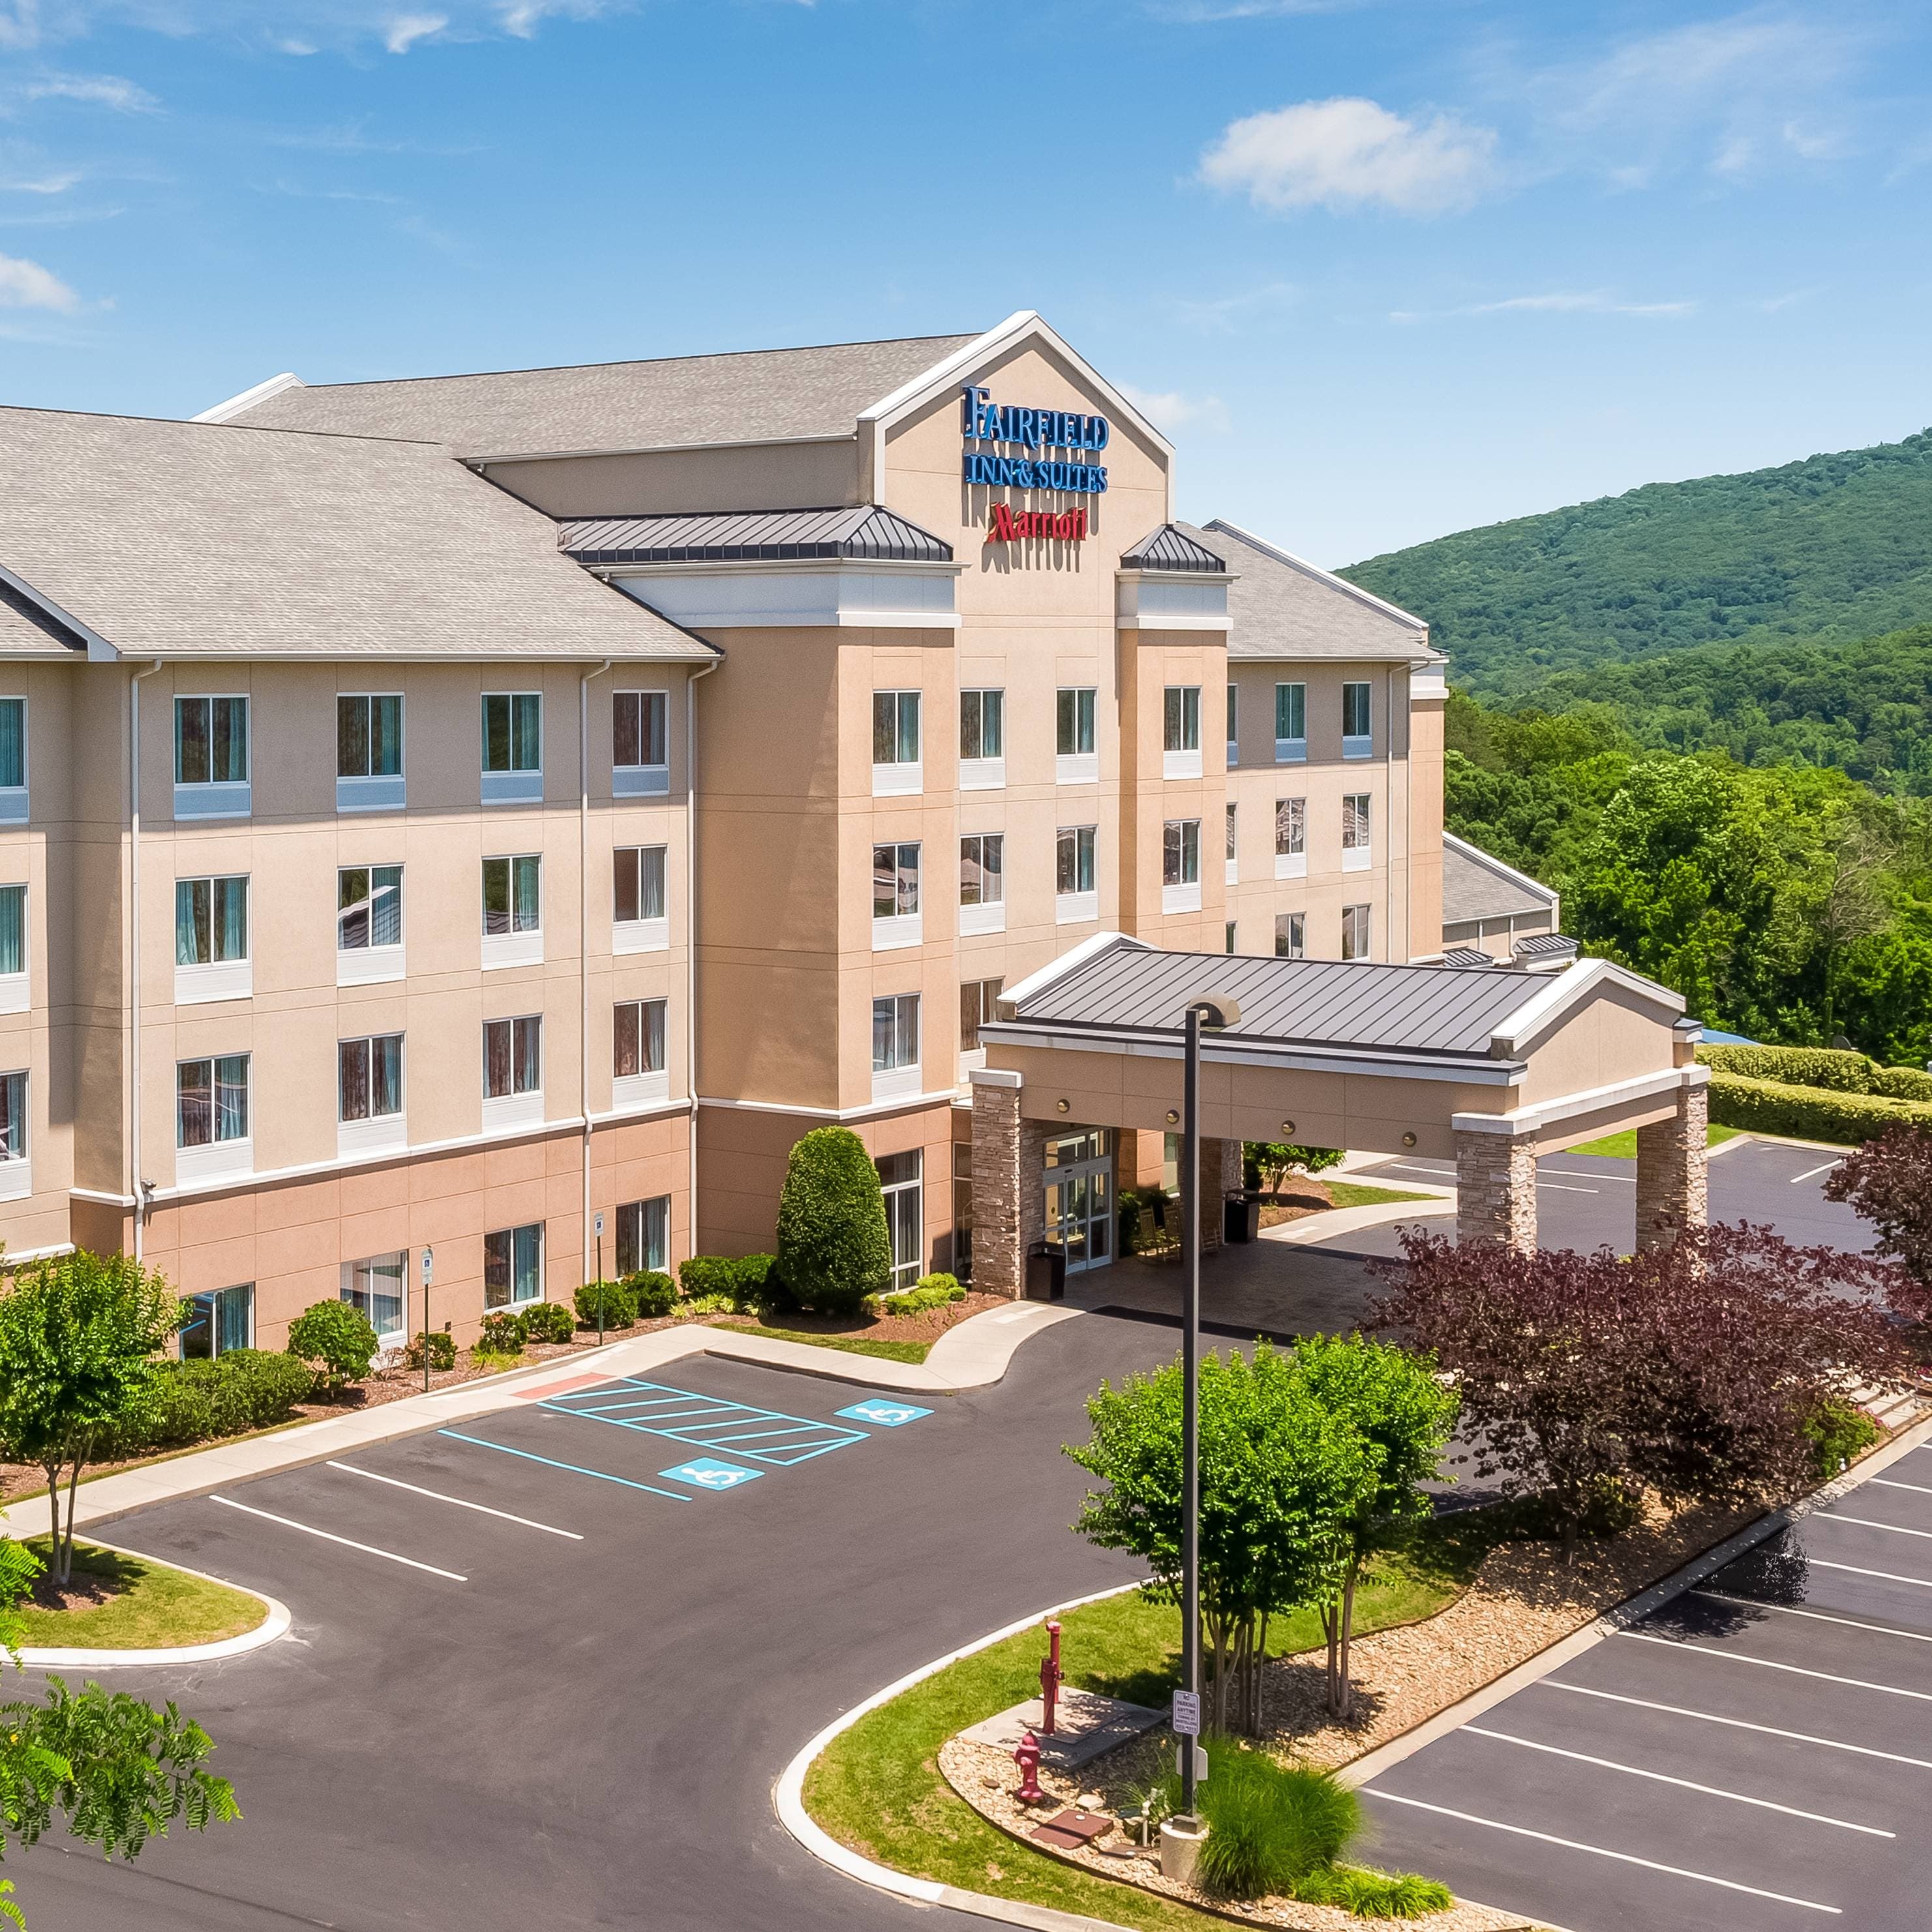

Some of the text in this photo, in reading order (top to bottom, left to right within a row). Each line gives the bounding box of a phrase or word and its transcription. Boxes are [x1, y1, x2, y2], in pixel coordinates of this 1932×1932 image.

[963, 386, 1109, 451] FAIRFIELD
[984, 502, 1087, 543] Marriott
[1177, 1700, 1196, 1709] PARKING
